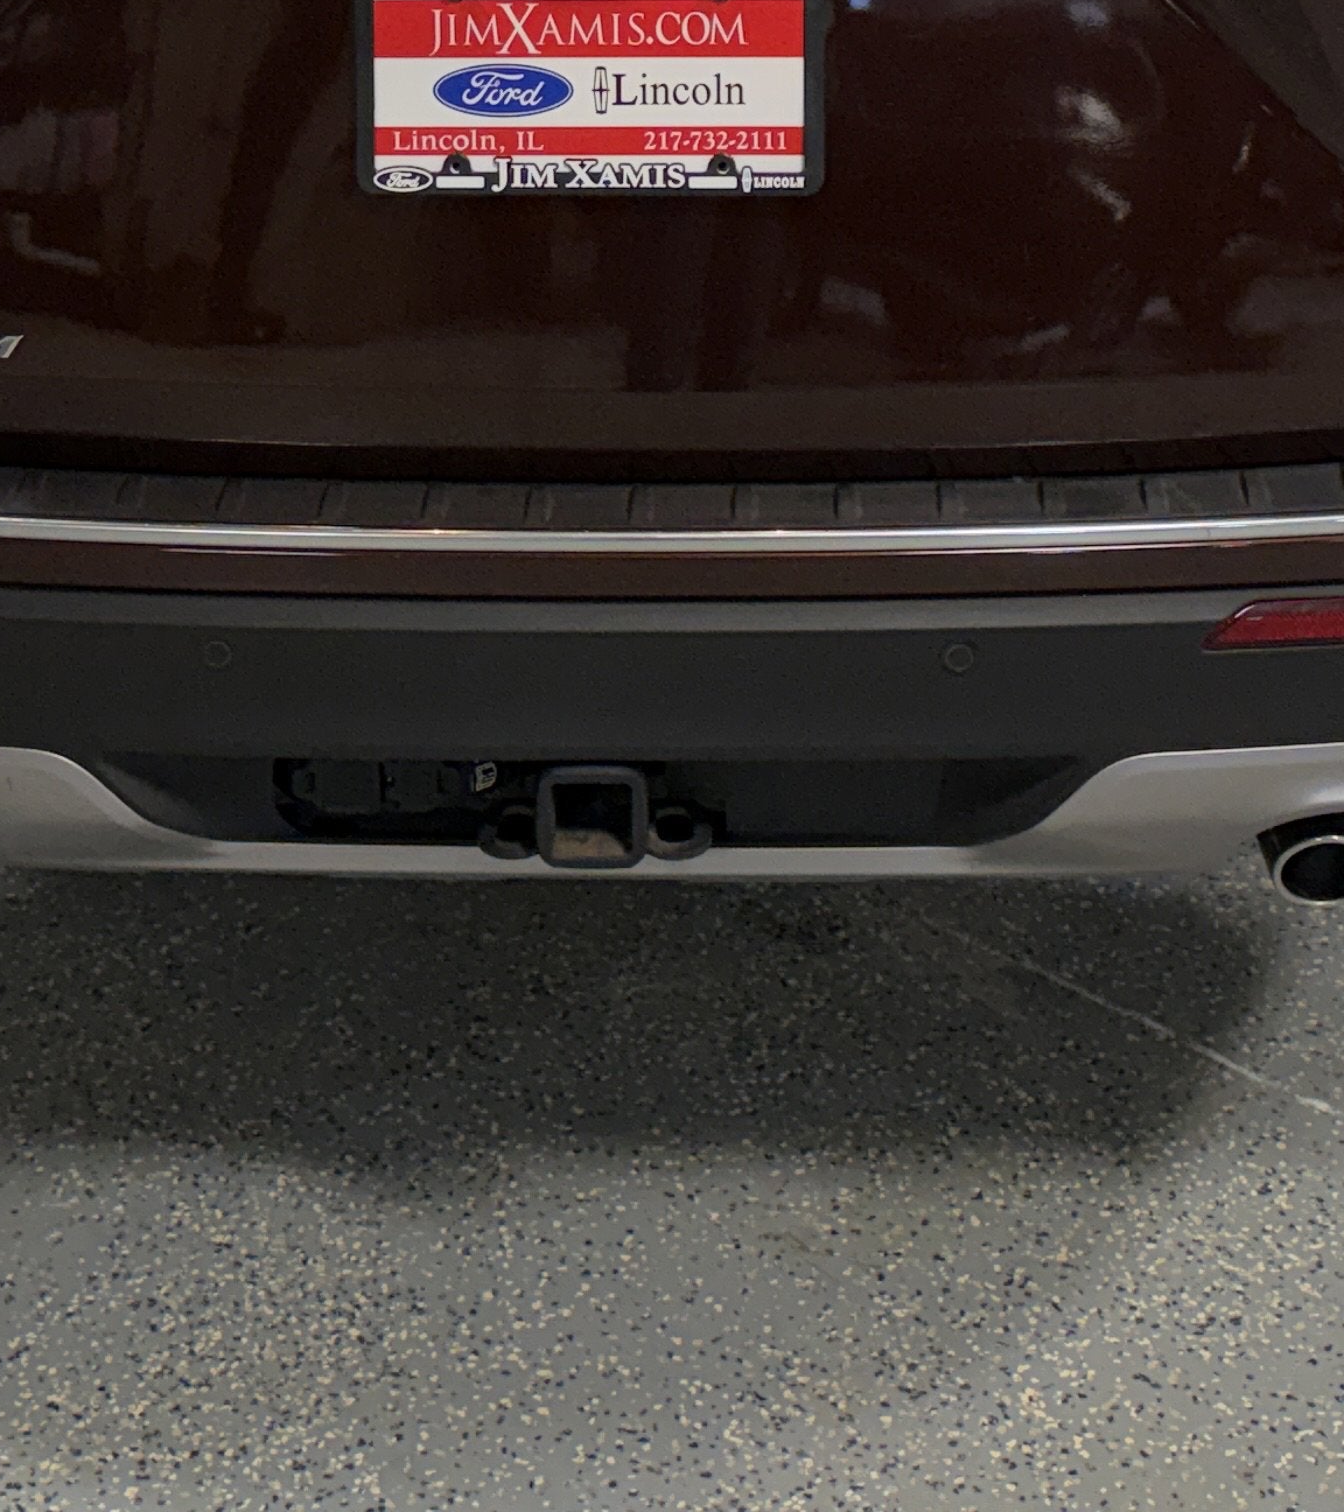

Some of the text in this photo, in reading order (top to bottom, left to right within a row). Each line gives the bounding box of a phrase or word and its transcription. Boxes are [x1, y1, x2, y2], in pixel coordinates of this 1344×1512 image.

[429, 2, 749, 56] JIMXAMIS.COM
[461, 71, 543, 107] Ford
[611, 73, 746, 106] Lincoln
[393, 129, 544, 153] Lincoln, IL
[643, 131, 787, 151] 217-732-2111
[491, 157, 687, 193] JIM XAMIS
[753, 176, 805, 188] LINCOLN
